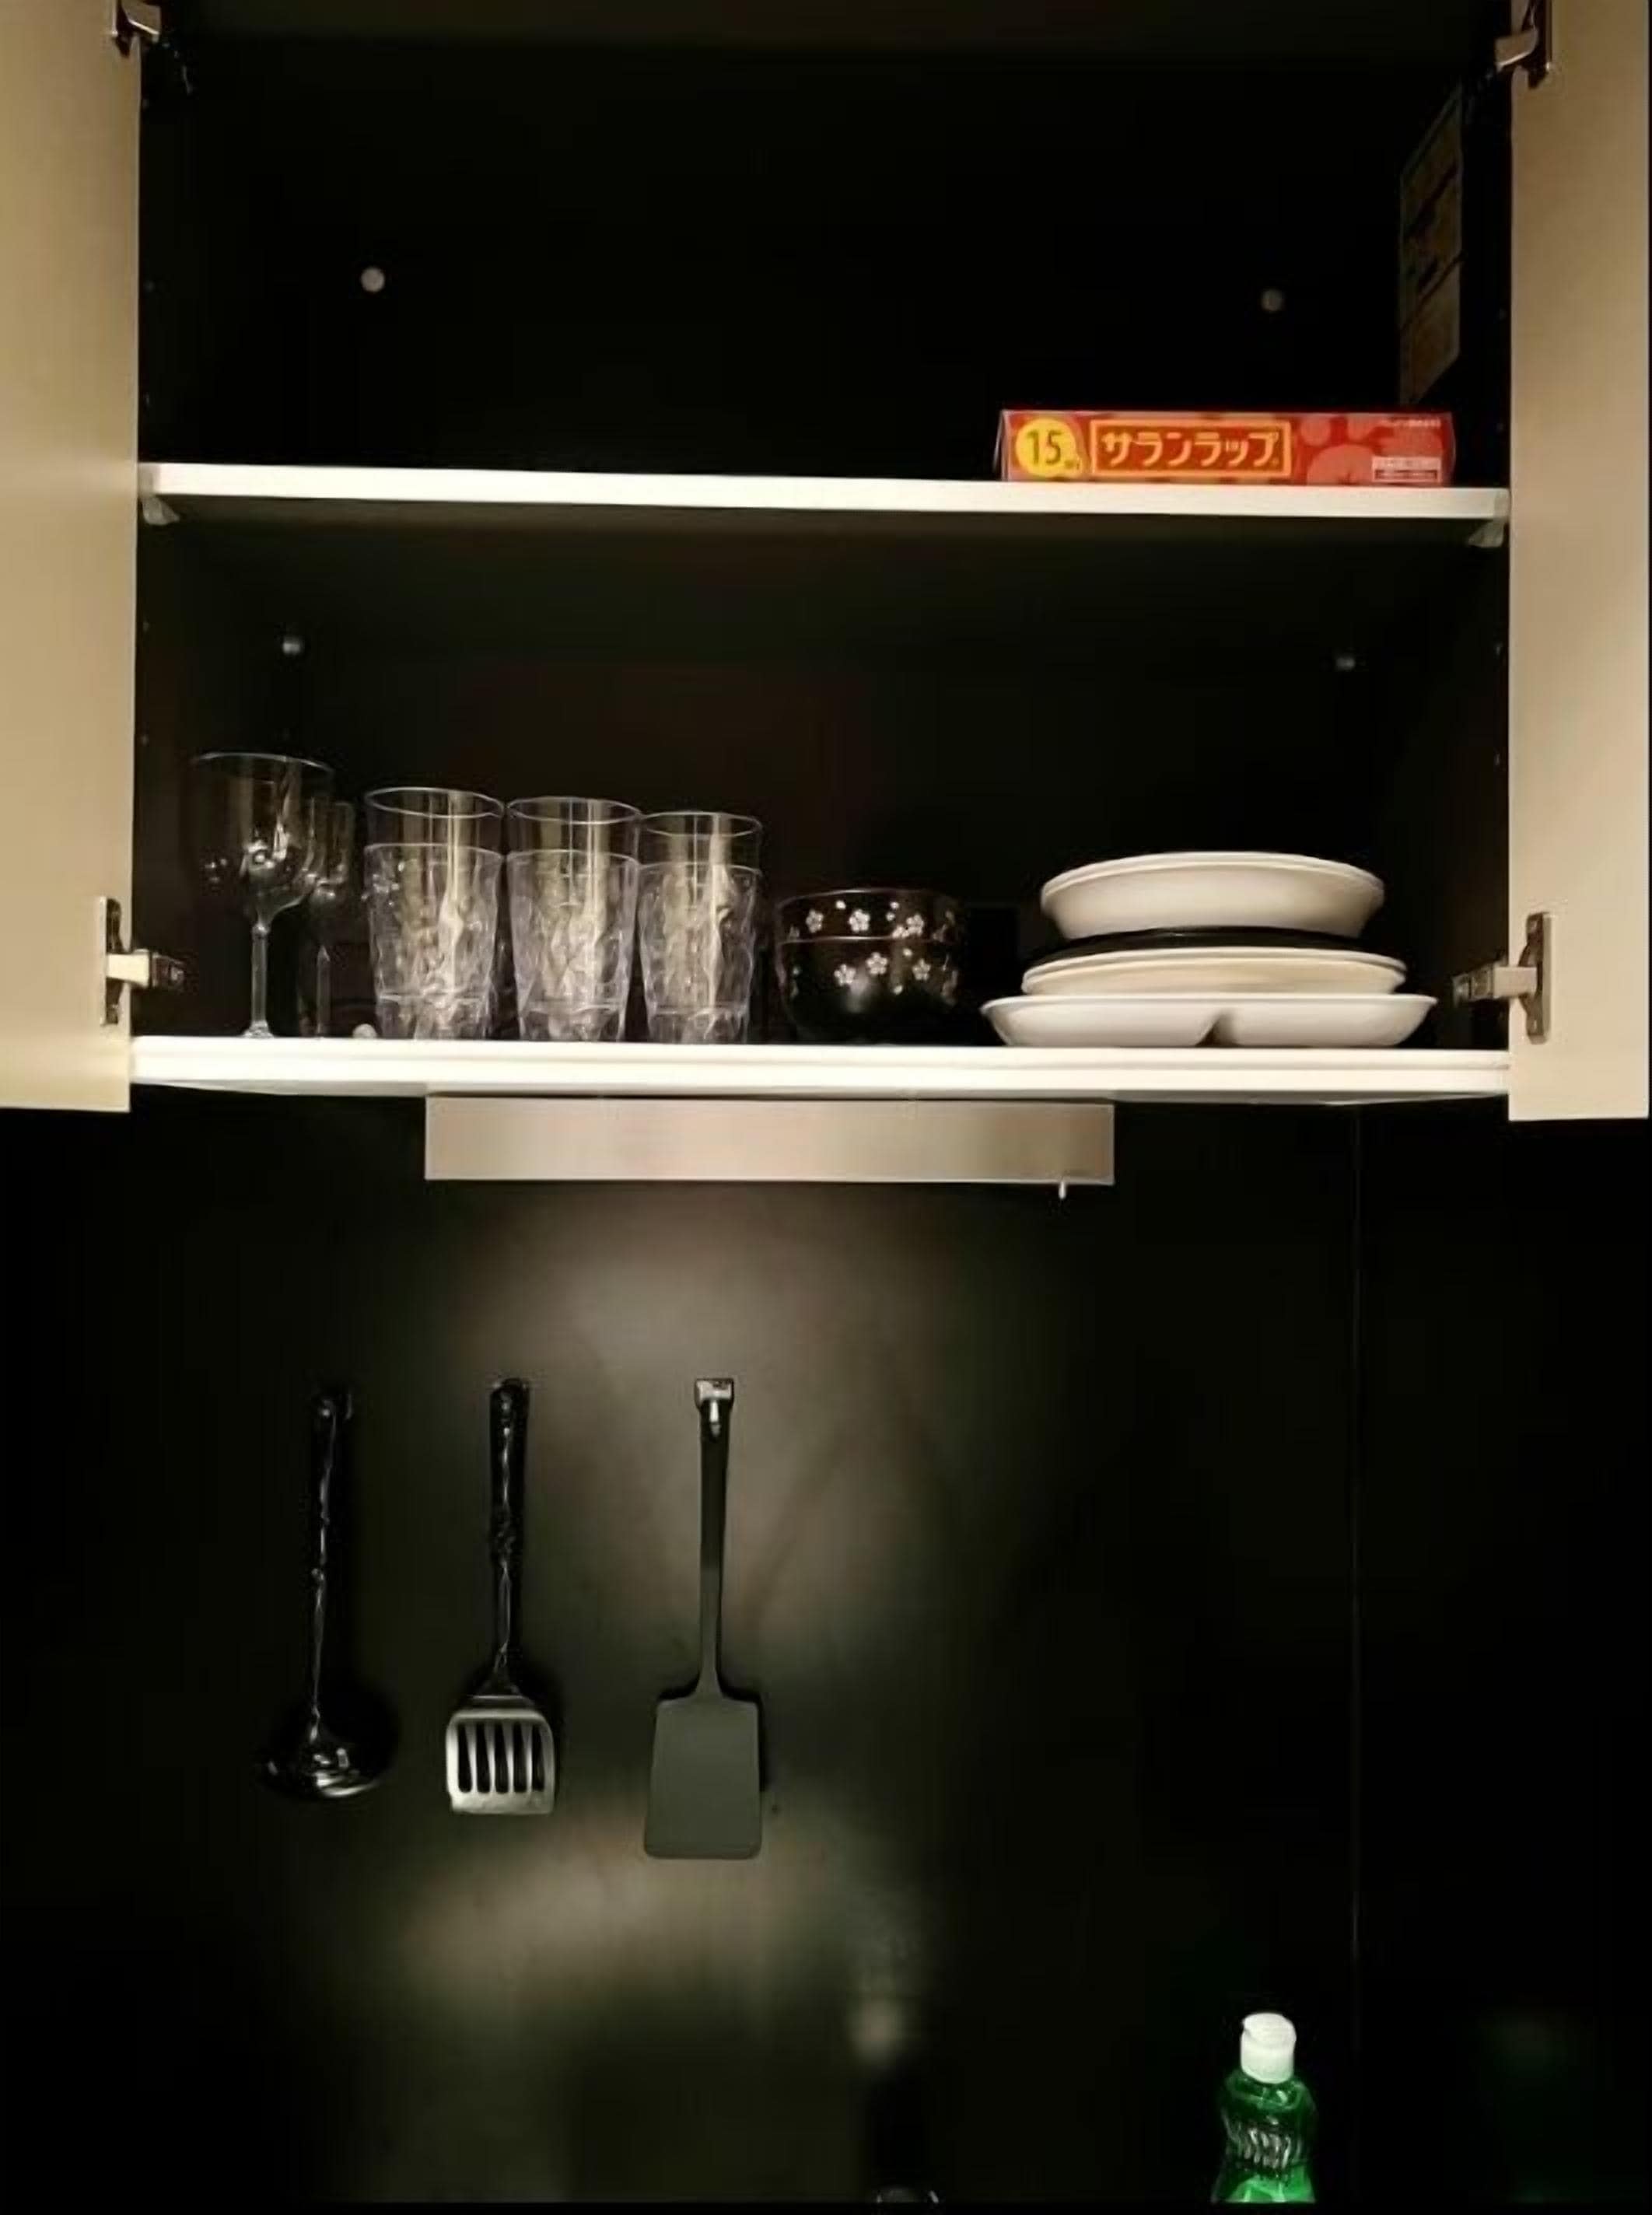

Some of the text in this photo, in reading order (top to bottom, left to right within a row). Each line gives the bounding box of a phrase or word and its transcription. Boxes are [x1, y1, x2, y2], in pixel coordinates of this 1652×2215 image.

[1101, 431, 1279, 467] サランラップ
